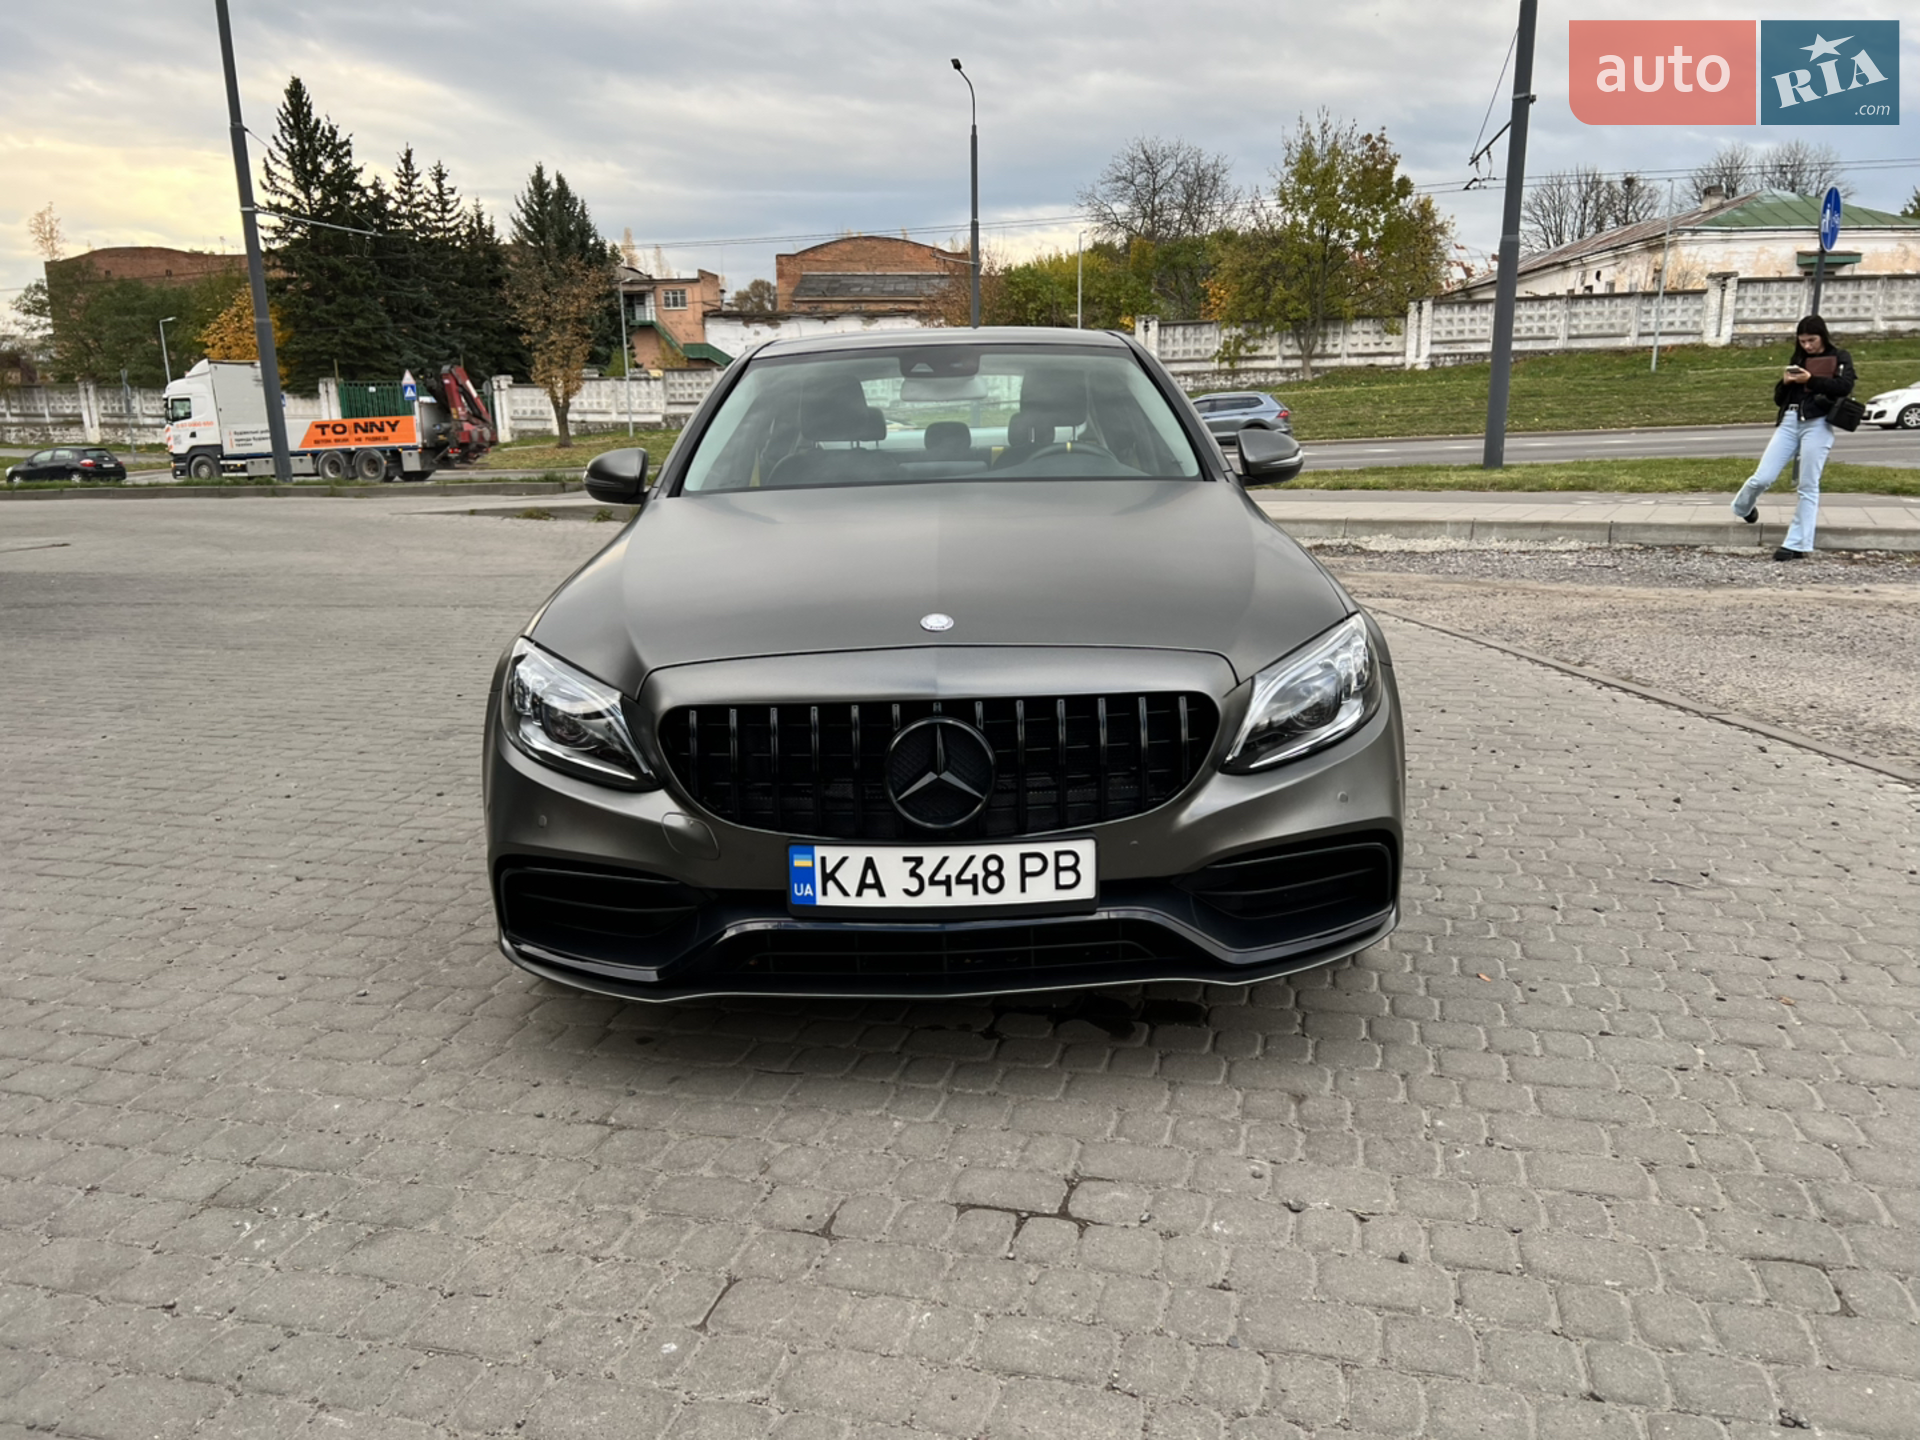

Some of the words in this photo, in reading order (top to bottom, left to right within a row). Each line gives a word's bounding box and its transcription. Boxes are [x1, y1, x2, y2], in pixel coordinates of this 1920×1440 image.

[820, 855, 887, 898] KA
[902, 854, 1005, 897] 3448
[1019, 849, 1082, 894] PB
[794, 883, 814, 897] UA
